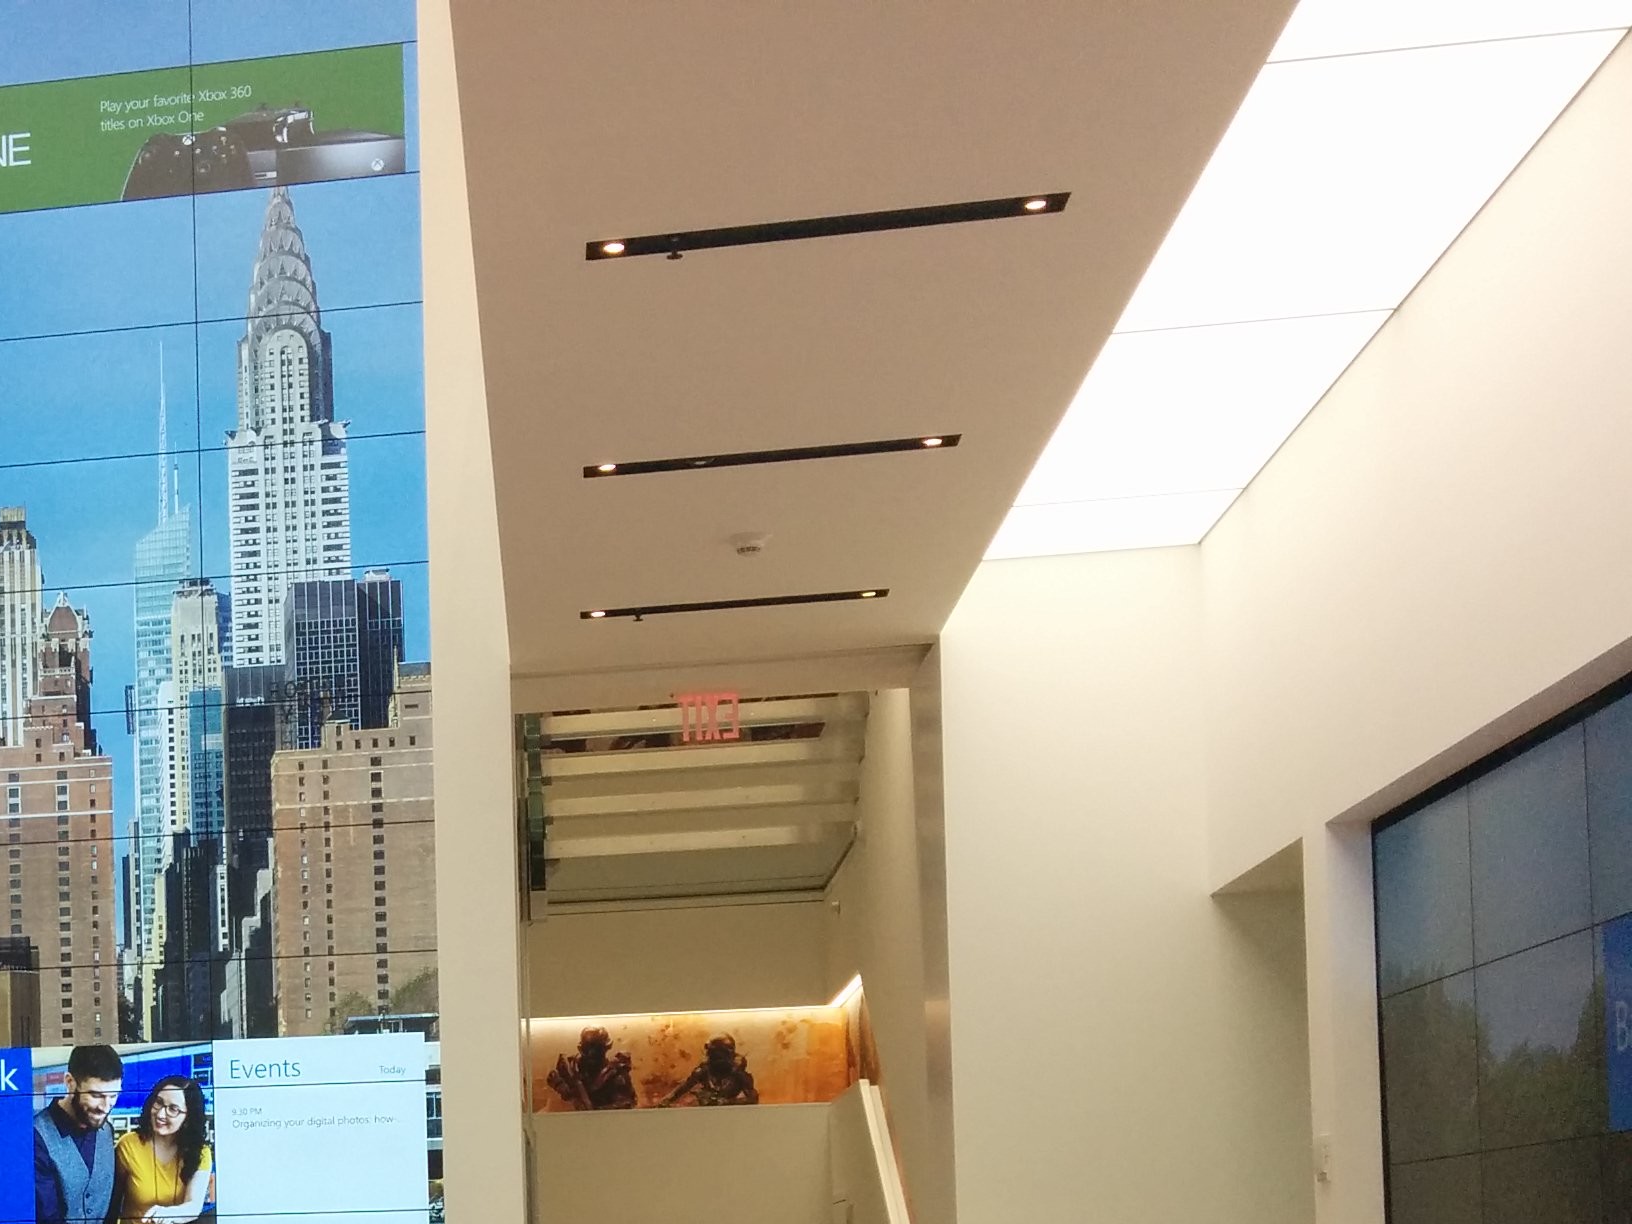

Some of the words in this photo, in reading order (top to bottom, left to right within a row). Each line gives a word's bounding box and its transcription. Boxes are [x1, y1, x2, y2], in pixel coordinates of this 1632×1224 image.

[100, 100, 122, 114] Play
[124, 99, 149, 113] your
[153, 93, 196, 107] favorite
[198, 90, 228, 102] Xbox
[230, 85, 253, 99] 360
[100, 119, 125, 132] titles
[128, 118, 144, 129] on
[147, 114, 175, 127] Xbox
[178, 110, 205, 123] One
[230, 1059, 301, 1080] Events
[379, 1065, 406, 1076] Today
[232, 1119, 282, 1131] Organizing
[284, 1119, 305, 1129] your
[307, 1115, 335, 1128] digital
